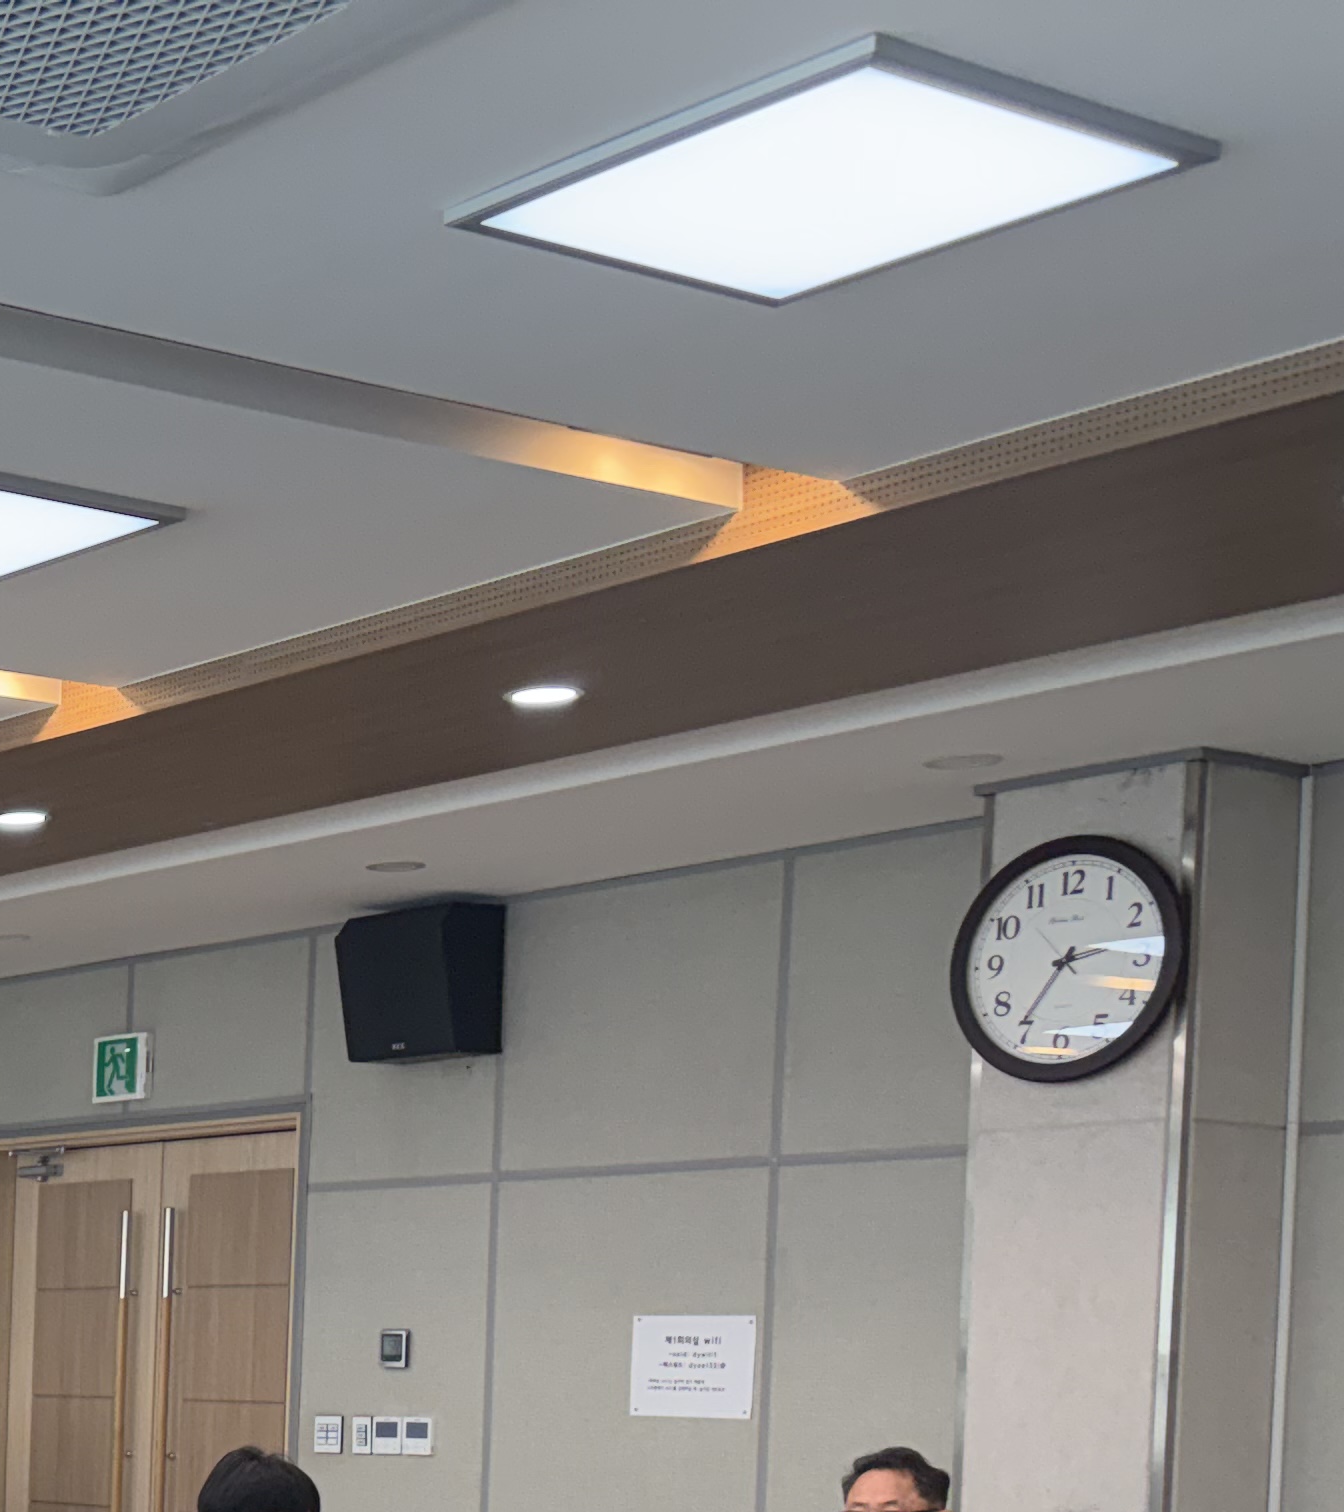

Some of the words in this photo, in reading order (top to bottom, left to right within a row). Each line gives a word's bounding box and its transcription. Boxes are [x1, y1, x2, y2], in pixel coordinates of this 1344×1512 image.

[1061, 869, 1086, 896] 12
[1106, 875, 1115, 901] 1
[1026, 883, 1045, 909] 11
[995, 915, 1021, 941] 10
[1127, 902, 1143, 928] 2
[987, 954, 1005, 980] 9
[993, 991, 1011, 1017] 8
[1118, 985, 1137, 1006] 4
[1018, 1019, 1035, 1045] 7
[1052, 1026, 1070, 1050] 6
